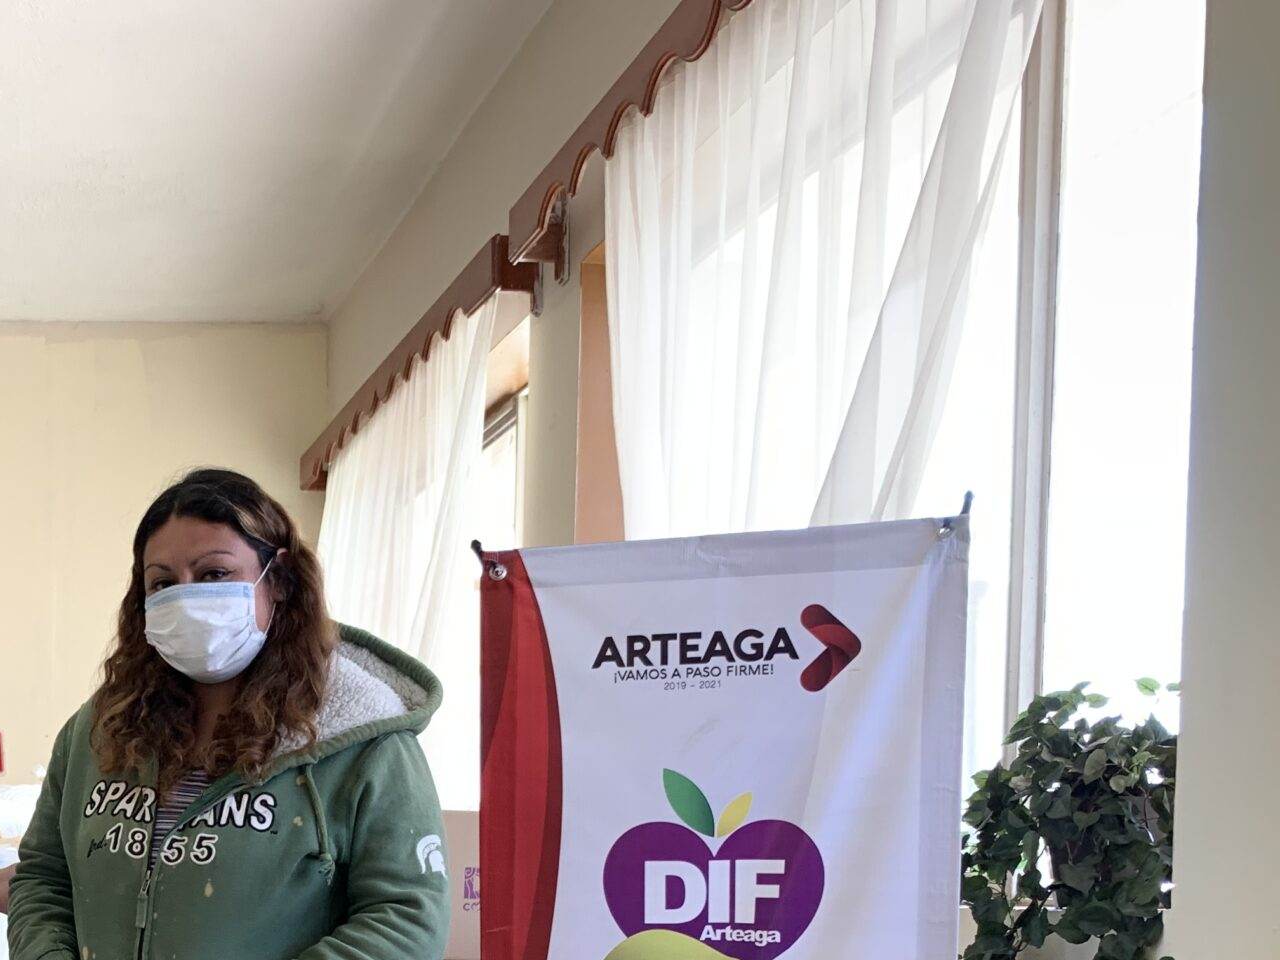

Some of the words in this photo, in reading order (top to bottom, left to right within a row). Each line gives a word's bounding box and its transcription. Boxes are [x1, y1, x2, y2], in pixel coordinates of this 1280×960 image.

[592, 627, 799, 669] ARTEAGA
[614, 668, 667, 683] ¡VAMOS
[671, 669, 681, 679] A
[686, 666, 721, 678] PASO
[726, 664, 774, 676] FIRME!
[664, 682, 687, 690] 2019
[699, 681, 721, 689] 2021
[84, 779, 277, 832] SPARANS
[106, 823, 219, 865] 1855
[644, 858, 785, 924] DIF
[699, 925, 782, 947] Arteaga
